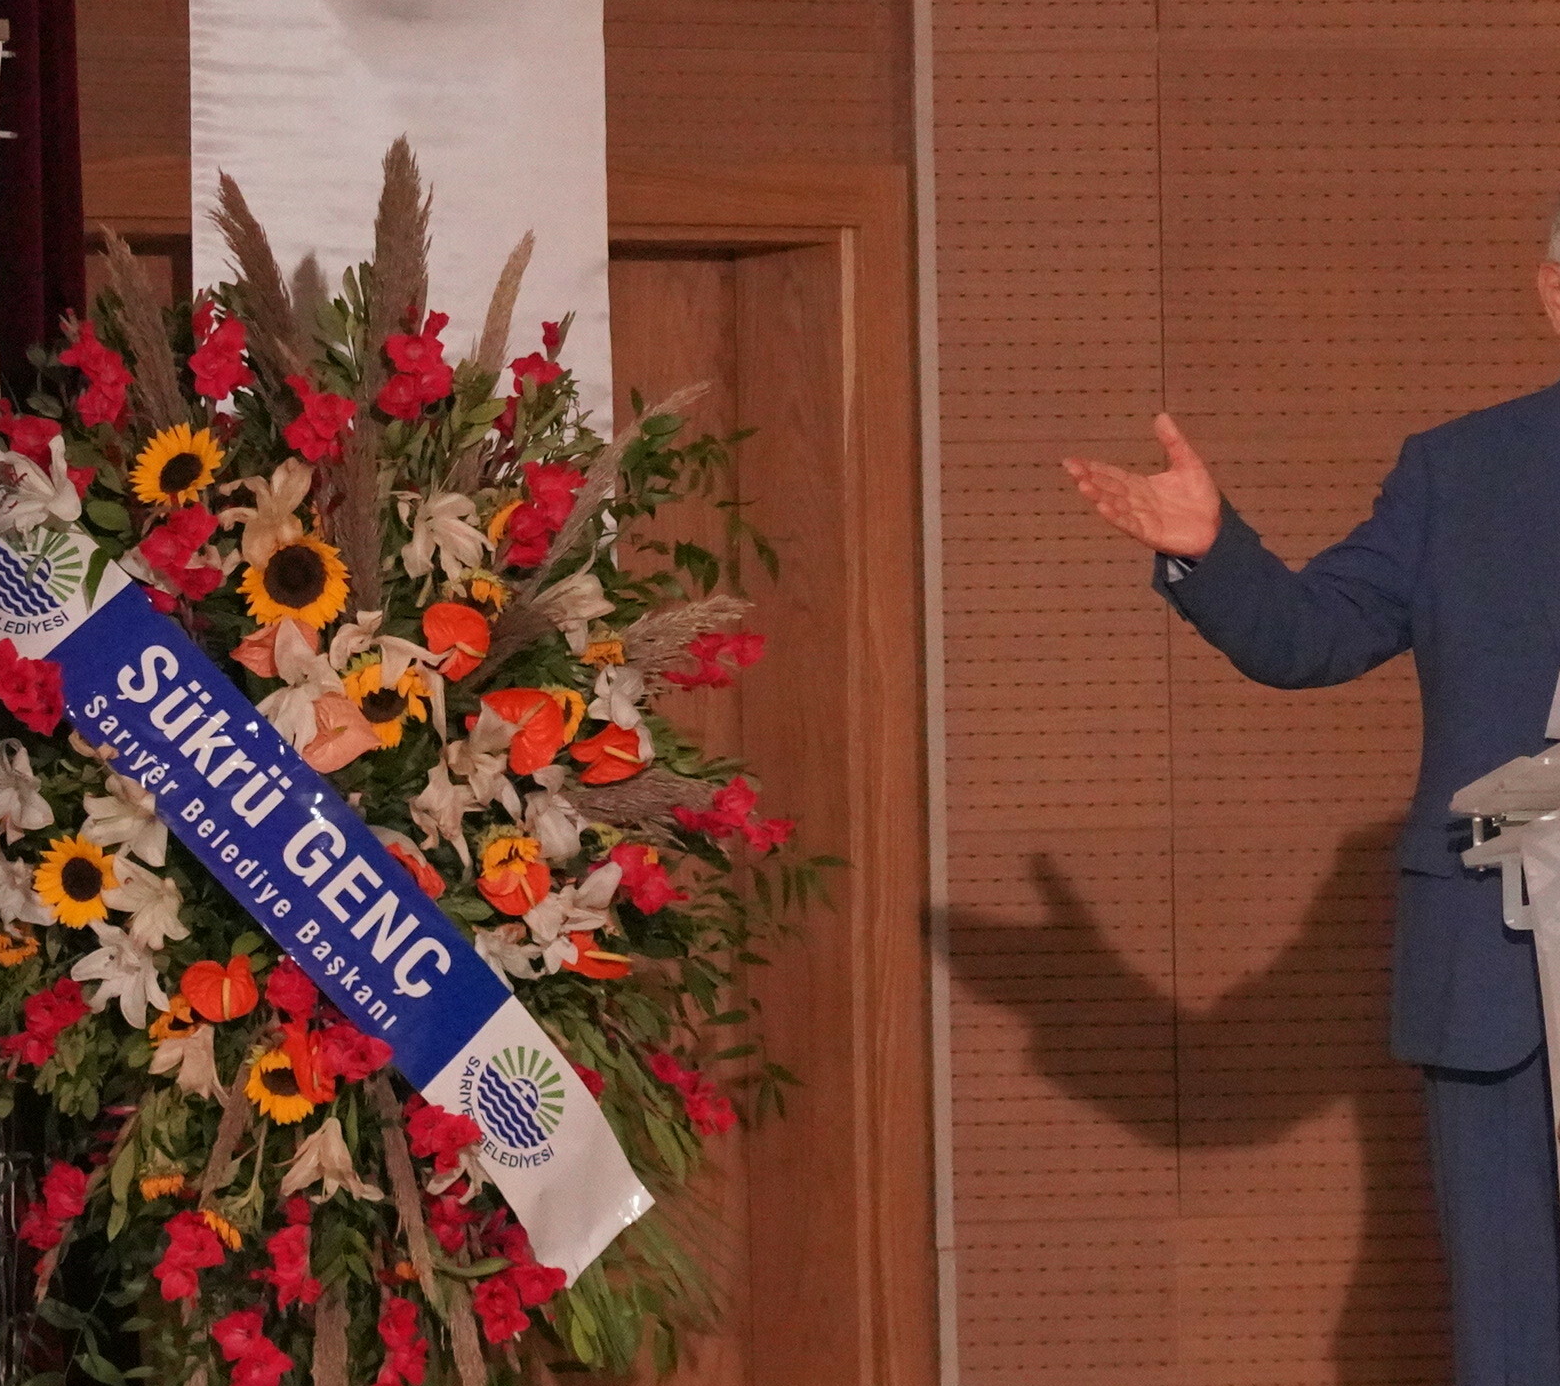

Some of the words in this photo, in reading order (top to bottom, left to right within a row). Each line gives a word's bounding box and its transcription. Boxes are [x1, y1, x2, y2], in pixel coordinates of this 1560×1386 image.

[84, 695, 179, 796] Sarıyer
[180, 797, 292, 918] Belediye
[295, 919, 397, 1031] Başkanı
[116, 645, 293, 828] Şükrü
[283, 819, 452, 998] GENÇ
[460, 1055, 482, 1125] SARIYE
